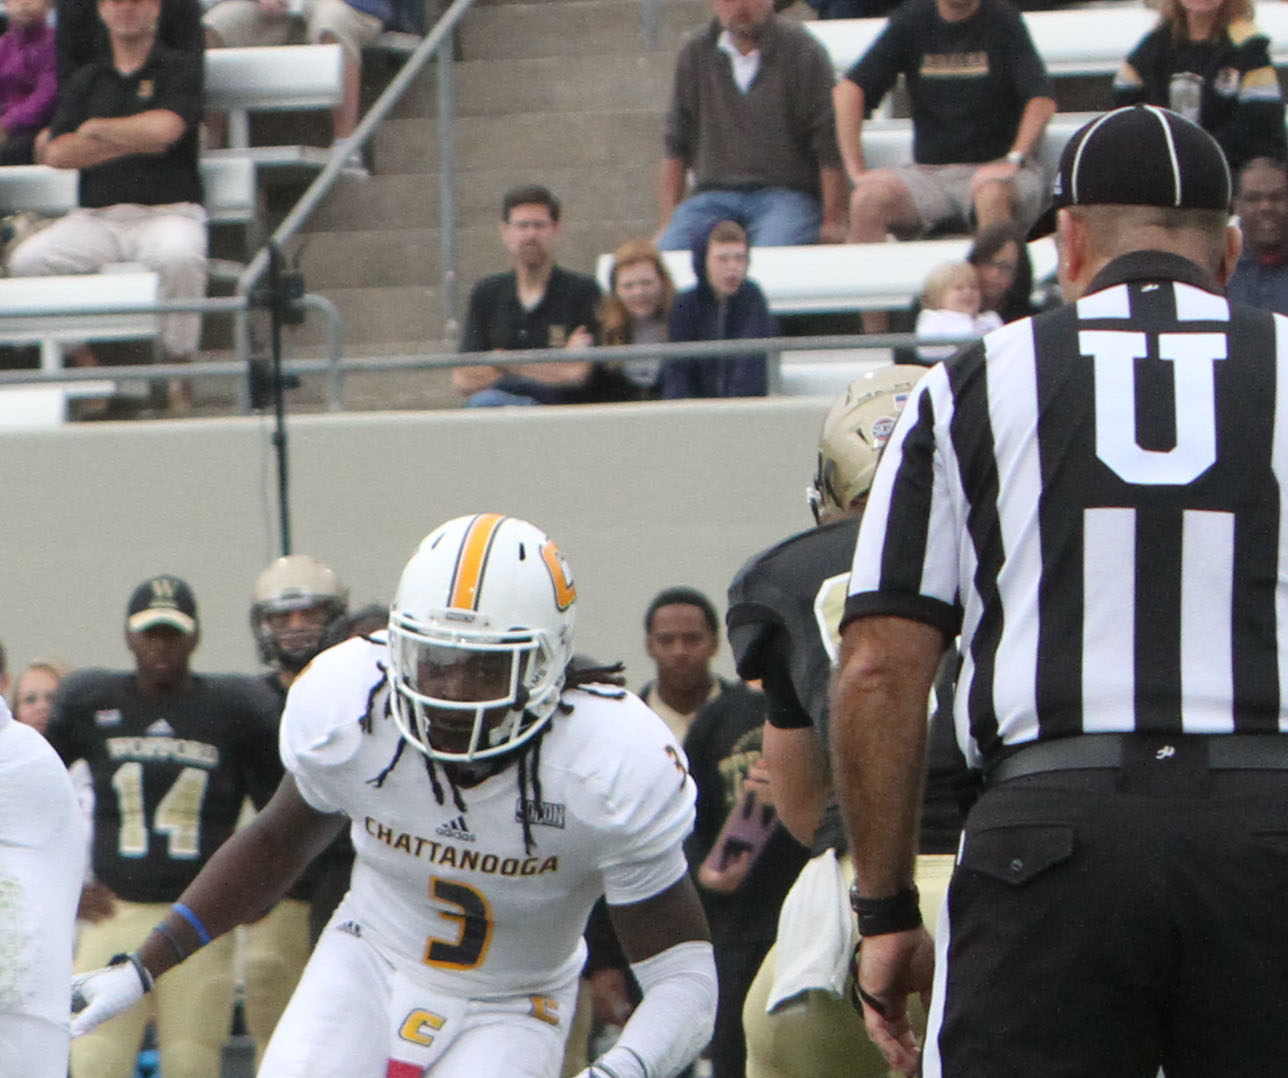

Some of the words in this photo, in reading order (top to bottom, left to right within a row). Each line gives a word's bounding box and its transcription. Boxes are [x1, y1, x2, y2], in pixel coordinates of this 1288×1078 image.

[1078, 329, 1229, 485] U
[111, 760, 211, 858] 14
[365, 816, 560, 877] CHATTANOOGA
[435, 826, 477, 843] adidas
[422, 874, 495, 973] 3
[398, 1007, 447, 1048] C
